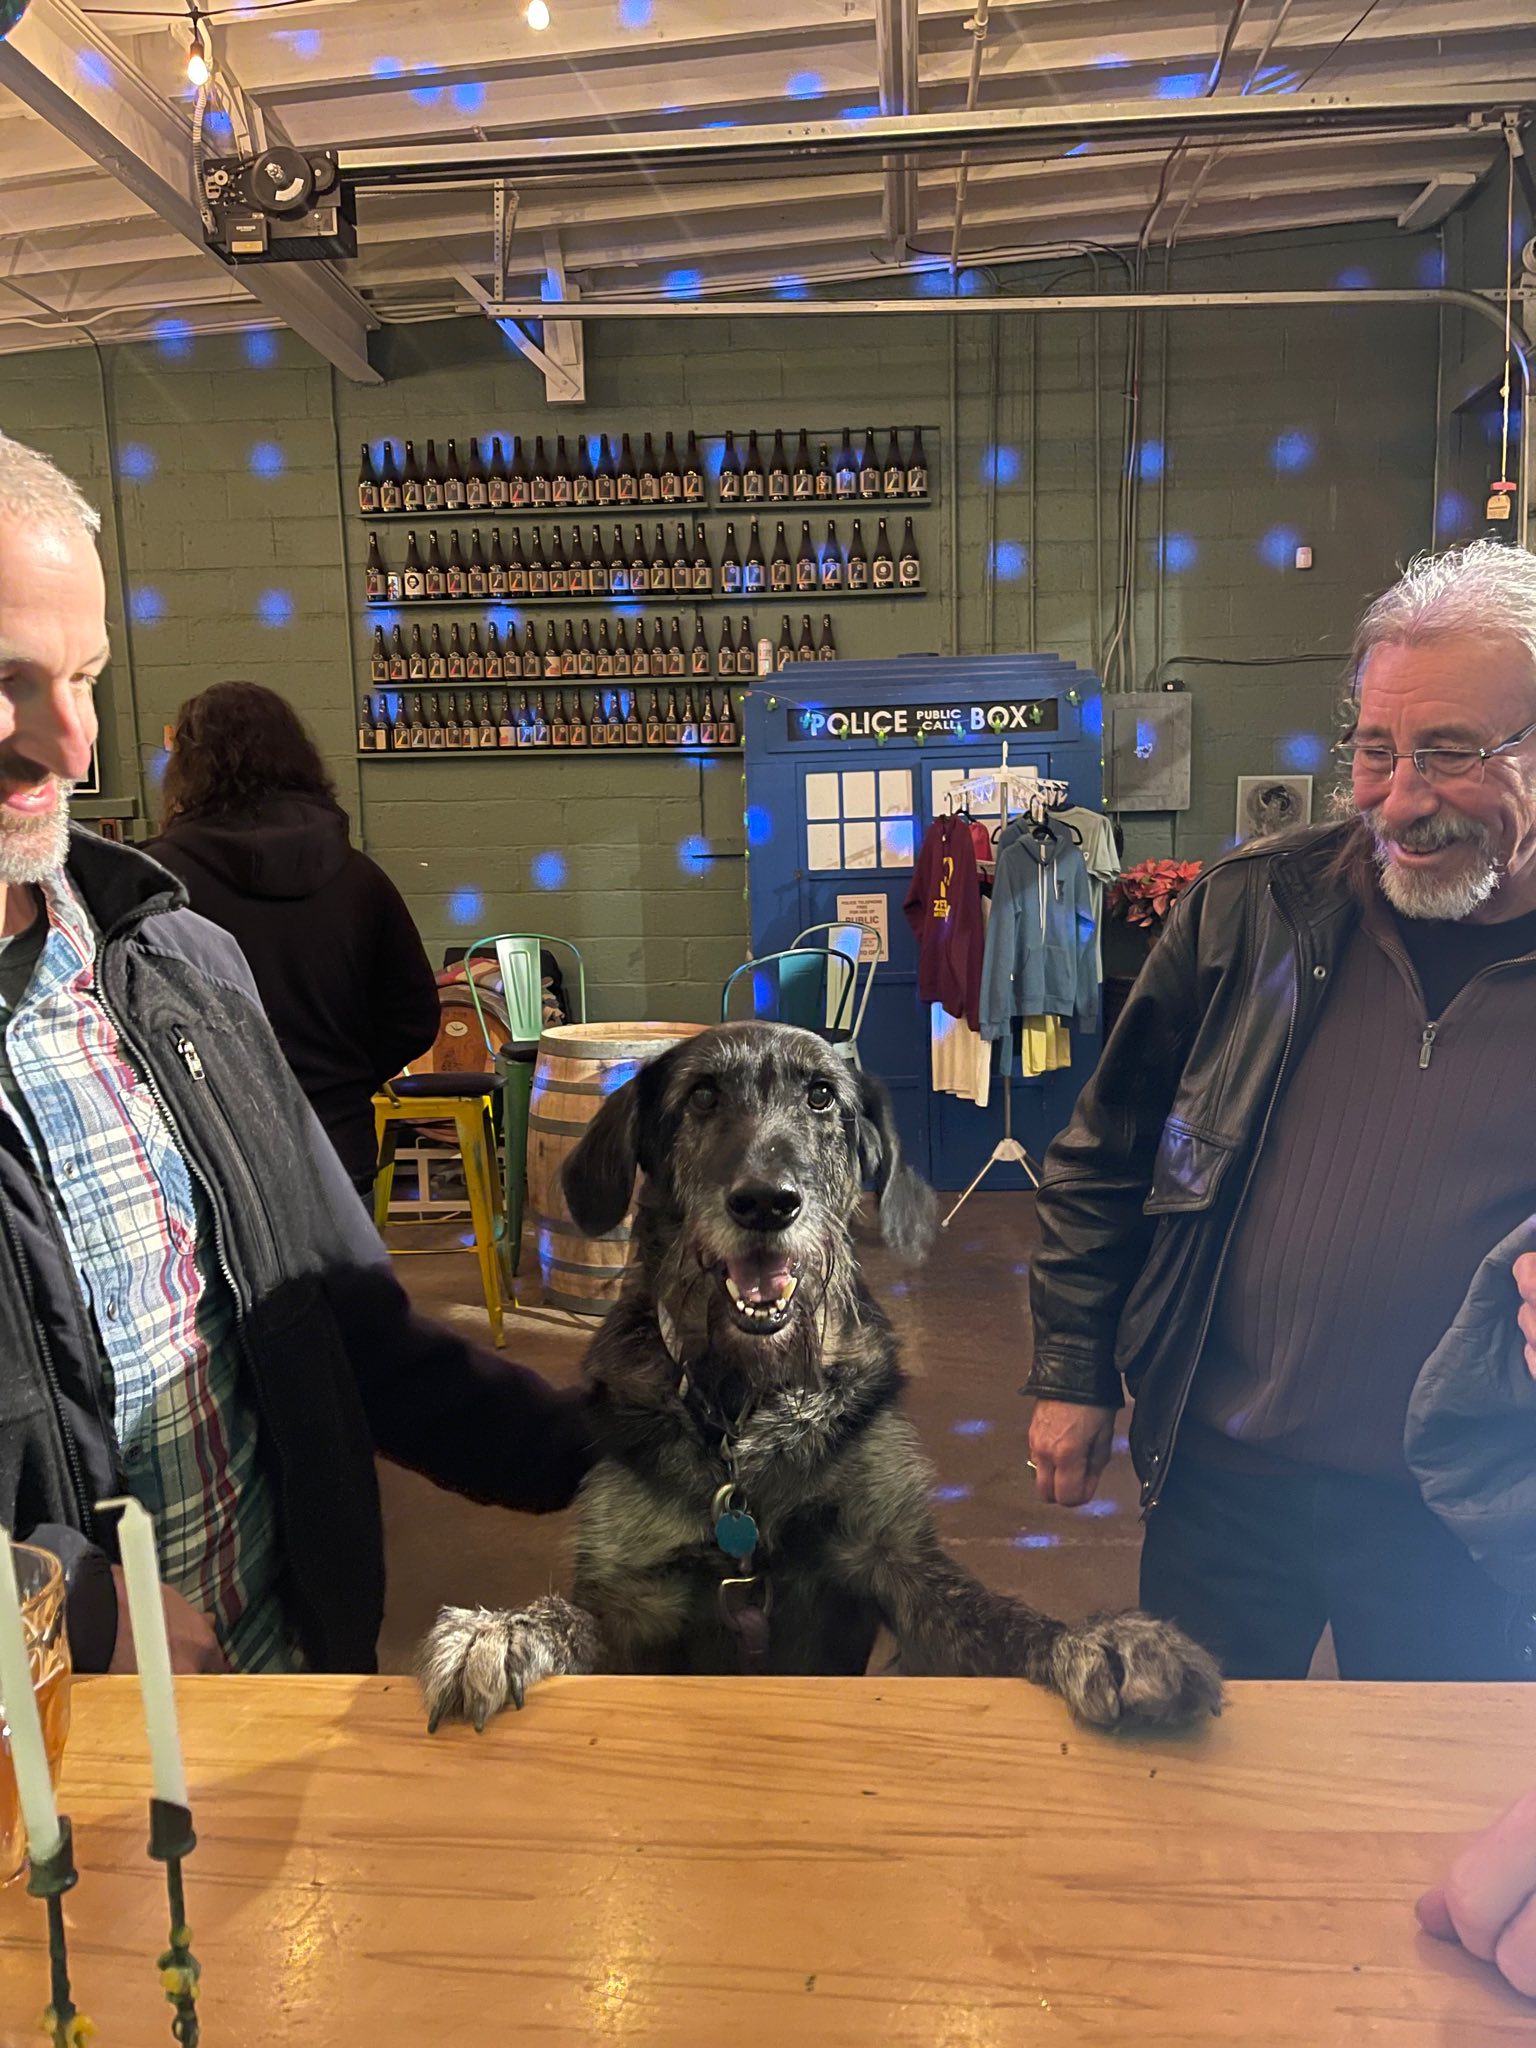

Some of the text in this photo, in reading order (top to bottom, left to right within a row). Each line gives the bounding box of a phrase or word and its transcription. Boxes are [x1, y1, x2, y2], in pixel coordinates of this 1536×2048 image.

[916, 709, 962, 720] PUBLIC
[970, 706, 1028, 729] BOX
[811, 710, 908, 736] POLICE
[921, 720, 957, 731] CALL
[845, 915, 880, 924] PUBLIC
